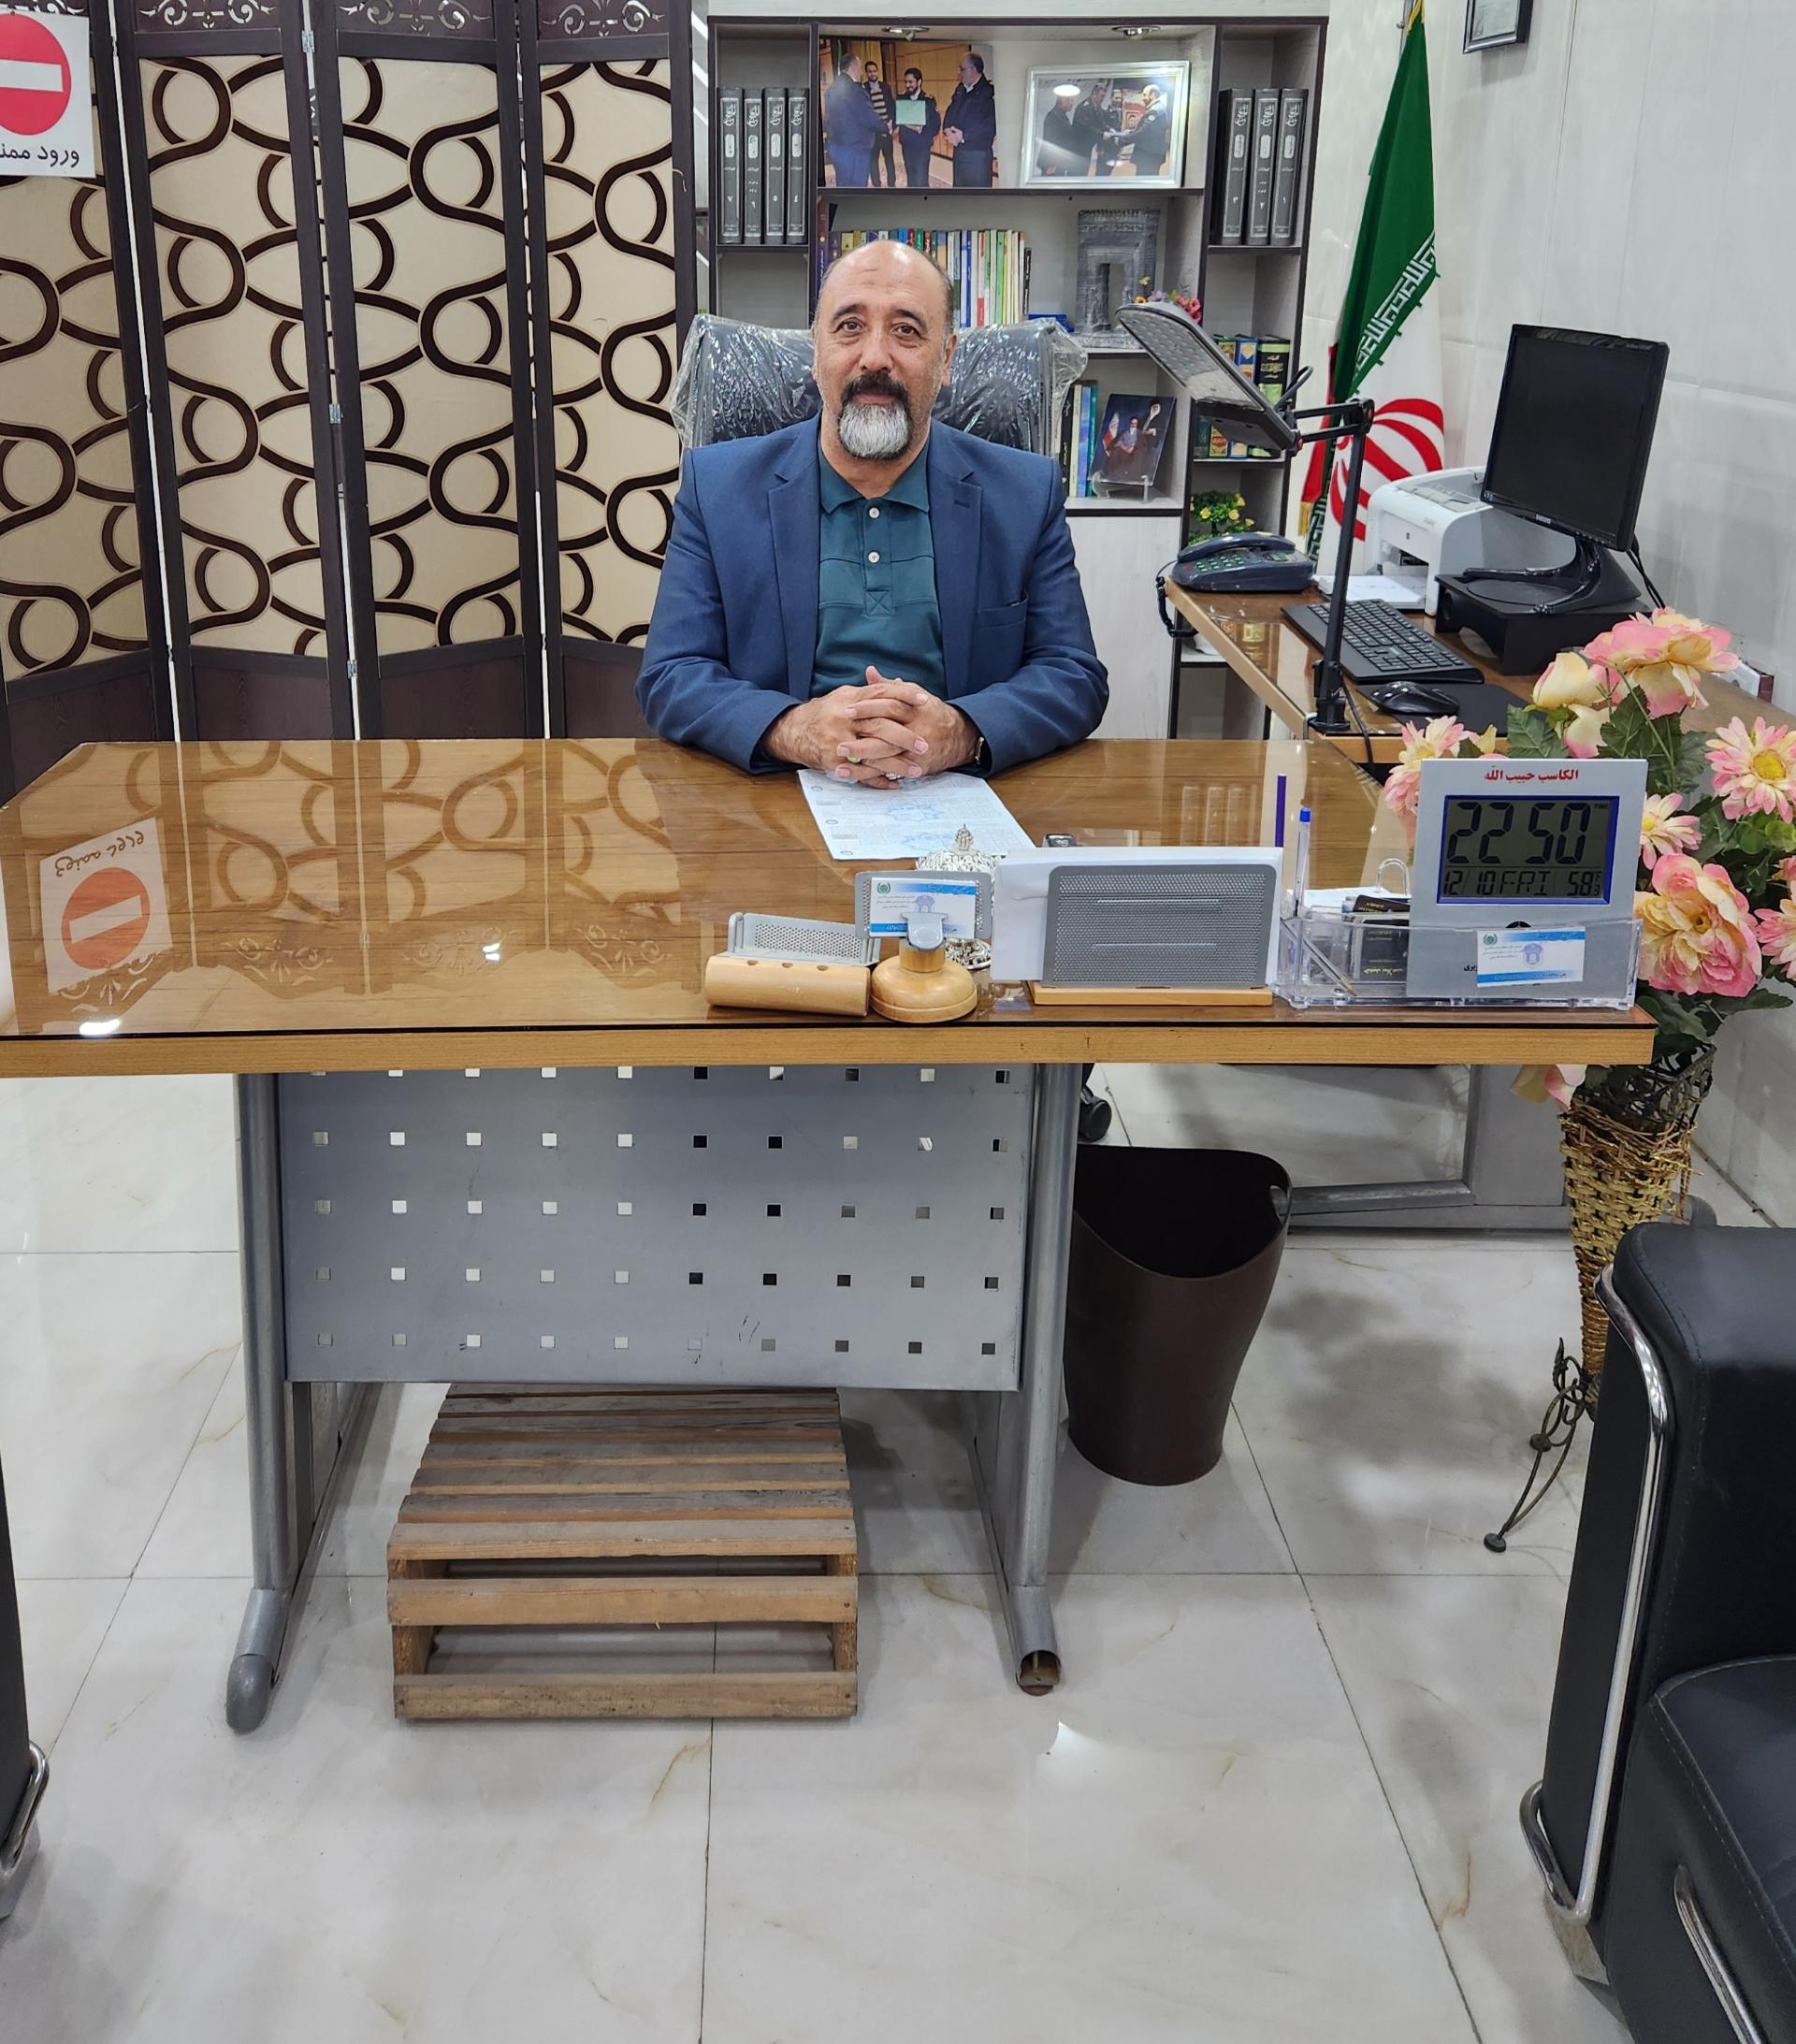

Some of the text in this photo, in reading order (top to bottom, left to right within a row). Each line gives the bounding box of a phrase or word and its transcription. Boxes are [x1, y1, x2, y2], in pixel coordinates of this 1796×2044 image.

[0, 143, 80, 167] ورود ممن
[1505, 771, 1535, 783] حبیب
[1538, 769, 1579, 783] الکاسب
[1499, 870, 1551, 895] FRI
